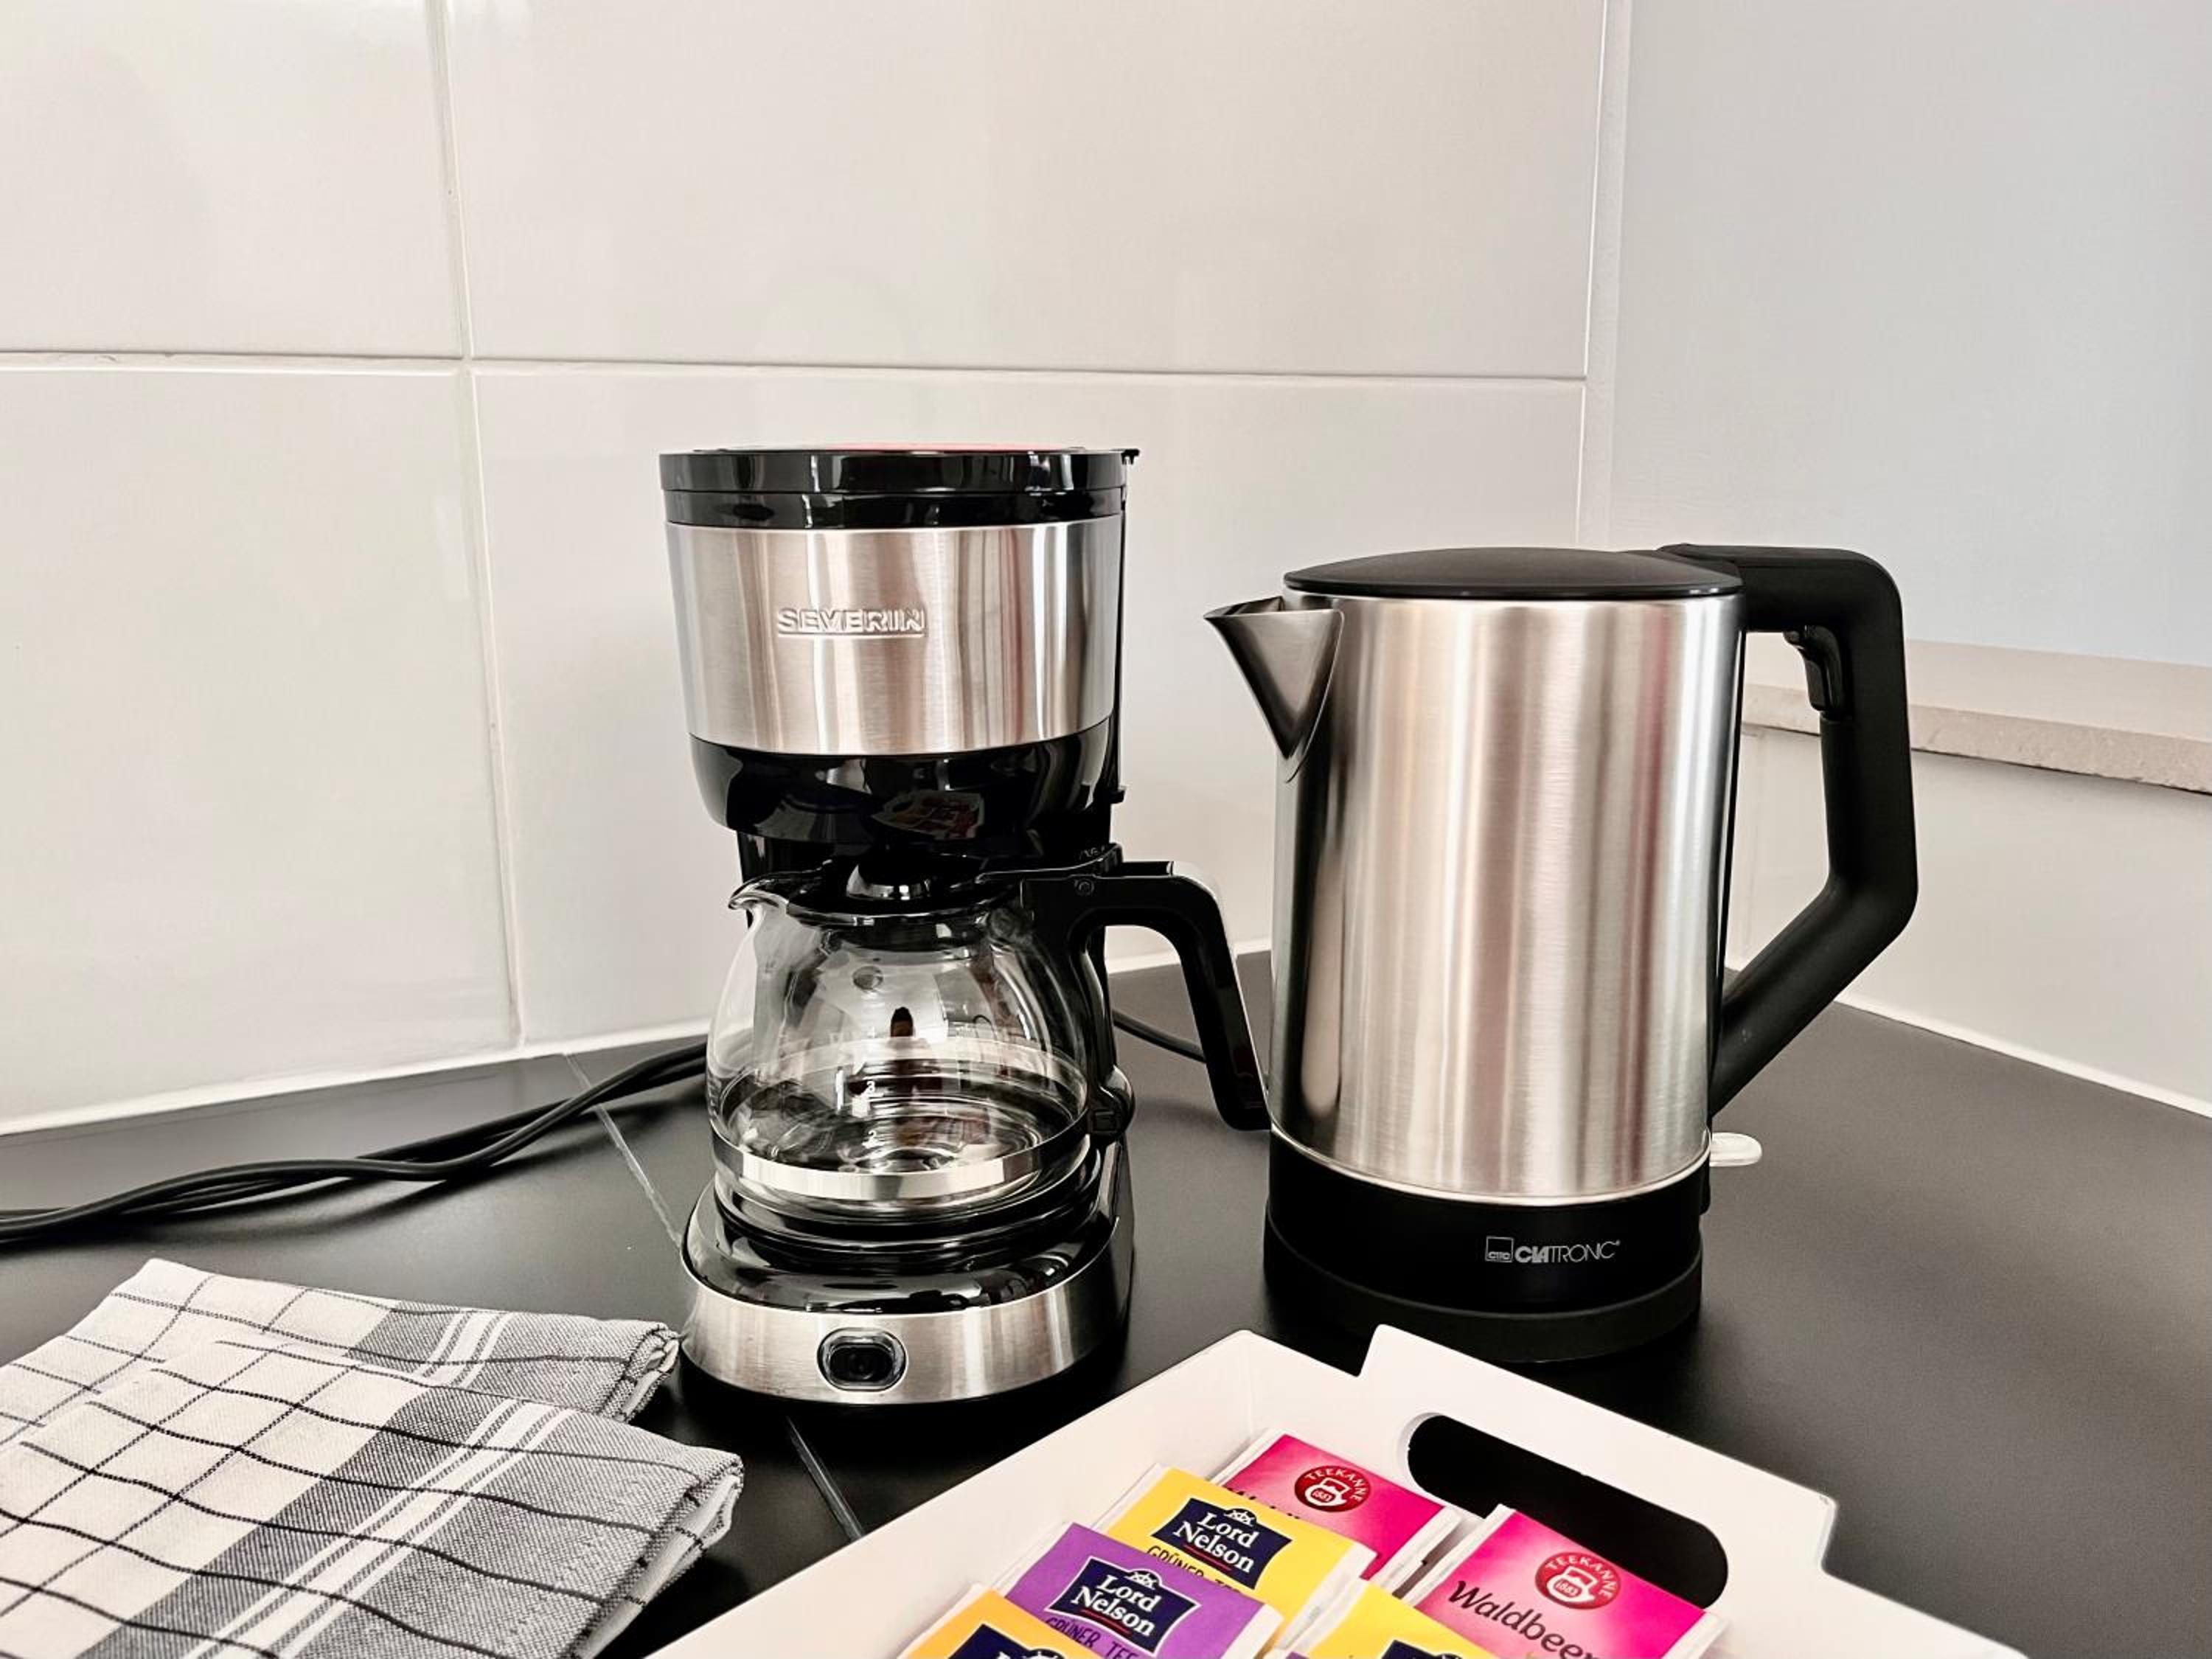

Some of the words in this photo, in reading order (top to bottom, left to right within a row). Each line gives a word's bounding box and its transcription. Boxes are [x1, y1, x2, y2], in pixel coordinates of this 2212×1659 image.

[777, 607, 927, 633] SEVERIN
[1304, 1468, 1367, 1502] TEEKANNE
[1172, 1520, 1255, 1573] Nelson
[1197, 1512, 1260, 1548] Lord
[1097, 1574, 1163, 1613] Lord
[1545, 1555, 1617, 1599] TEEKANNE
[1070, 1586, 1156, 1637] Nelson
